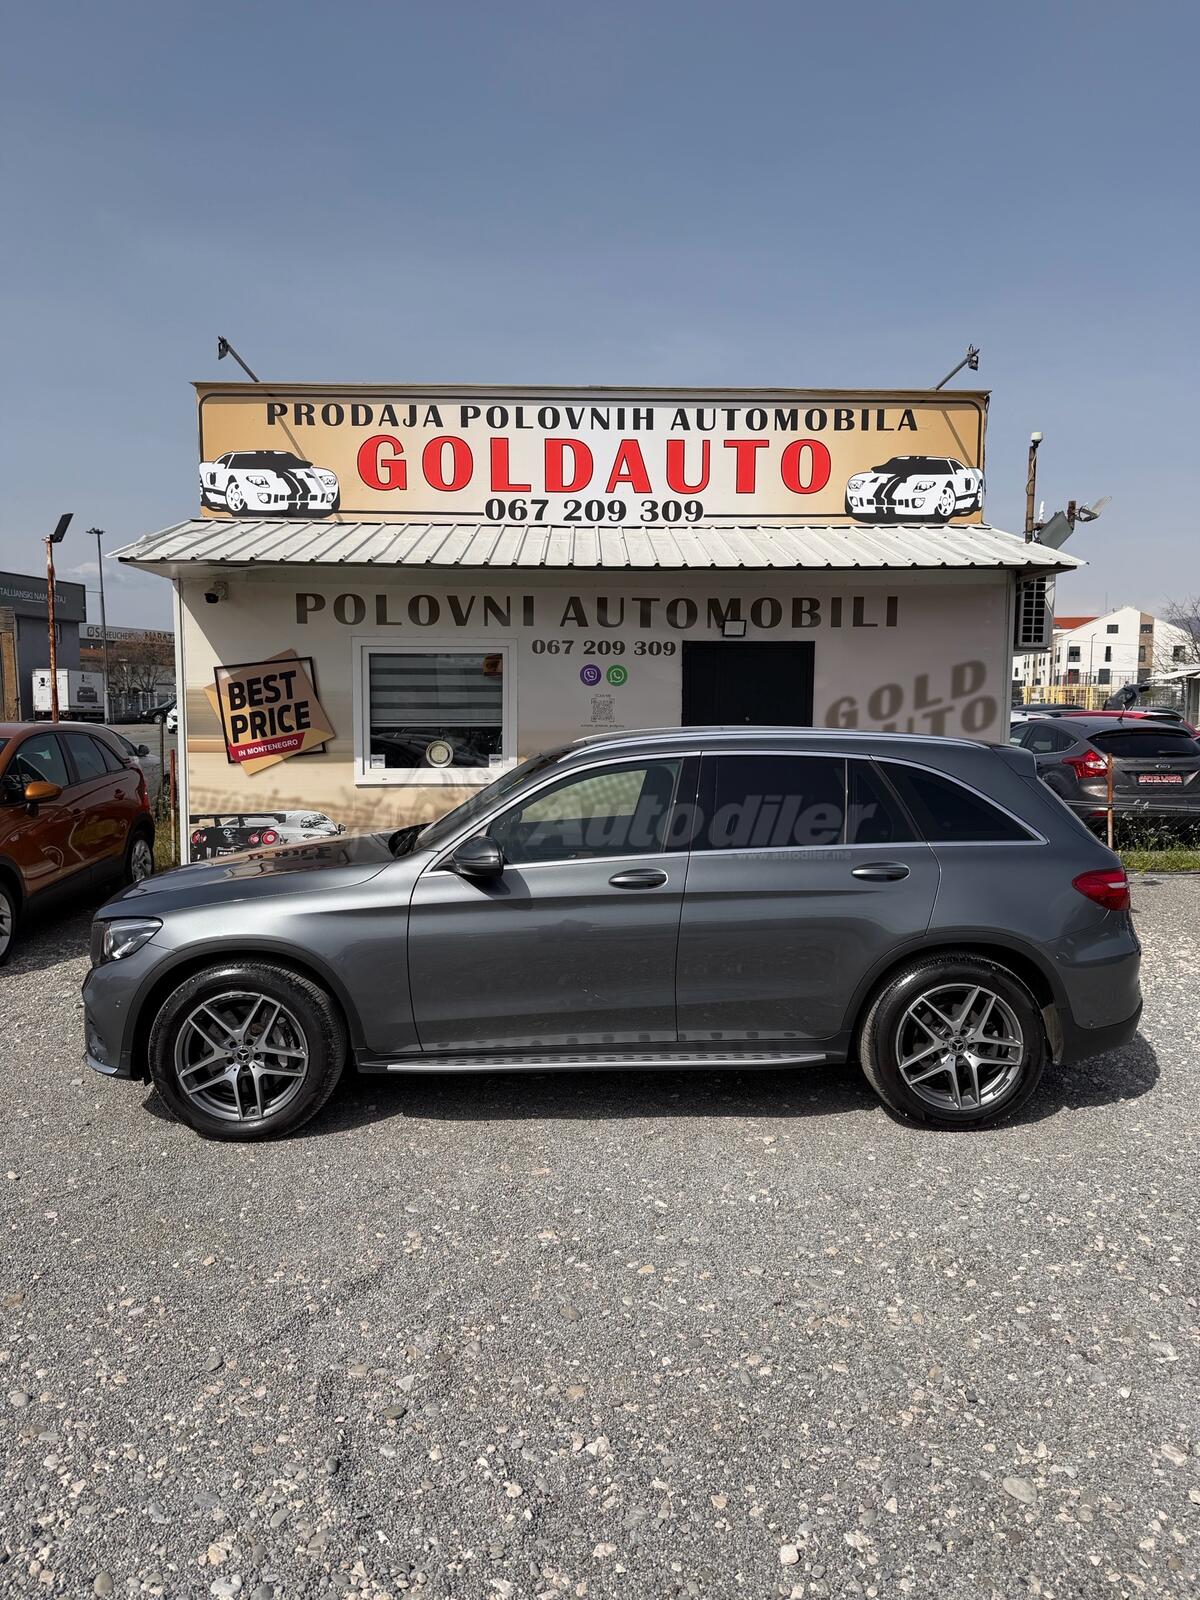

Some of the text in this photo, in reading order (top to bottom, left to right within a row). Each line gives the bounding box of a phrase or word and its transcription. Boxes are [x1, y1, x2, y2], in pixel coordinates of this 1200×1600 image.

[266, 402, 919, 432] PRODAJA POLOVNIH AUTOMOBILA
[356, 434, 832, 495] GOLDAUTO
[484, 498, 704, 523] 067 209 309
[295, 592, 899, 629] POLOVNI AUTOMOBILI
[531, 639, 676, 656] 067 209 309
[228, 669, 297, 711] BEST
[825, 659, 988, 729] GOLD
[230, 700, 311, 744] PRICE
[238, 738, 299, 758] IN MONTENEGRO
